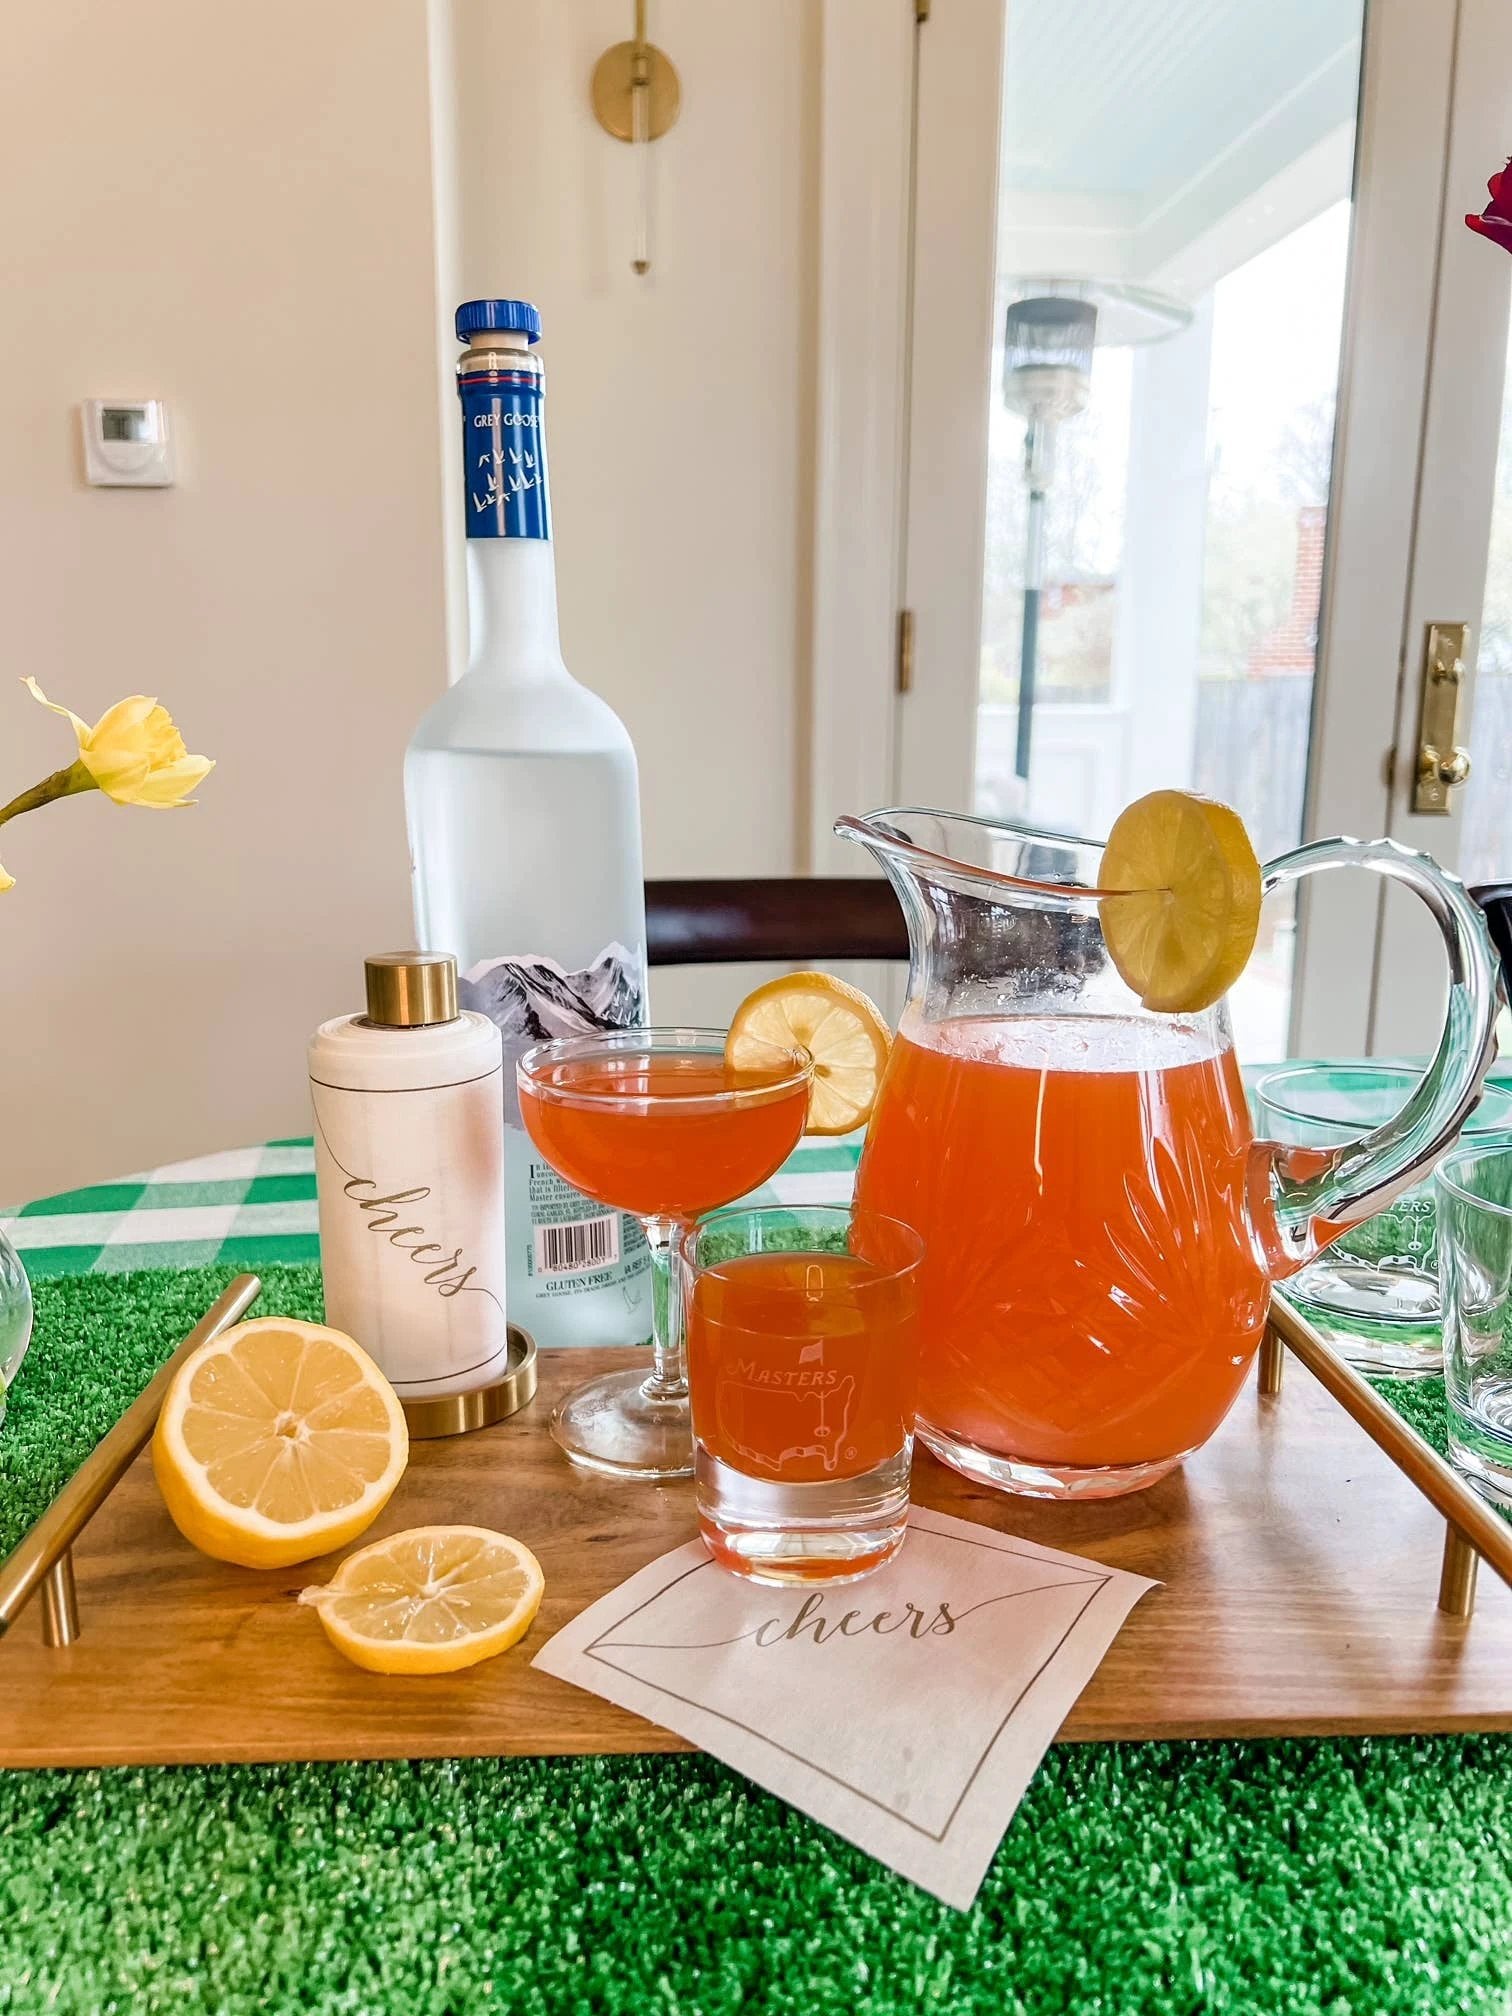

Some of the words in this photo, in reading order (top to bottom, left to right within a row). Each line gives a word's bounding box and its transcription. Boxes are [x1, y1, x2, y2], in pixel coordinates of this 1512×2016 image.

[474, 413, 500, 428] GREY
[1389, 1199, 1432, 1213] TERS
[343, 1178, 478, 1298] cheers
[545, 1277, 587, 1291] GLUTEN
[588, 1271, 613, 1286] FREE
[755, 1592, 957, 1648] cheers
